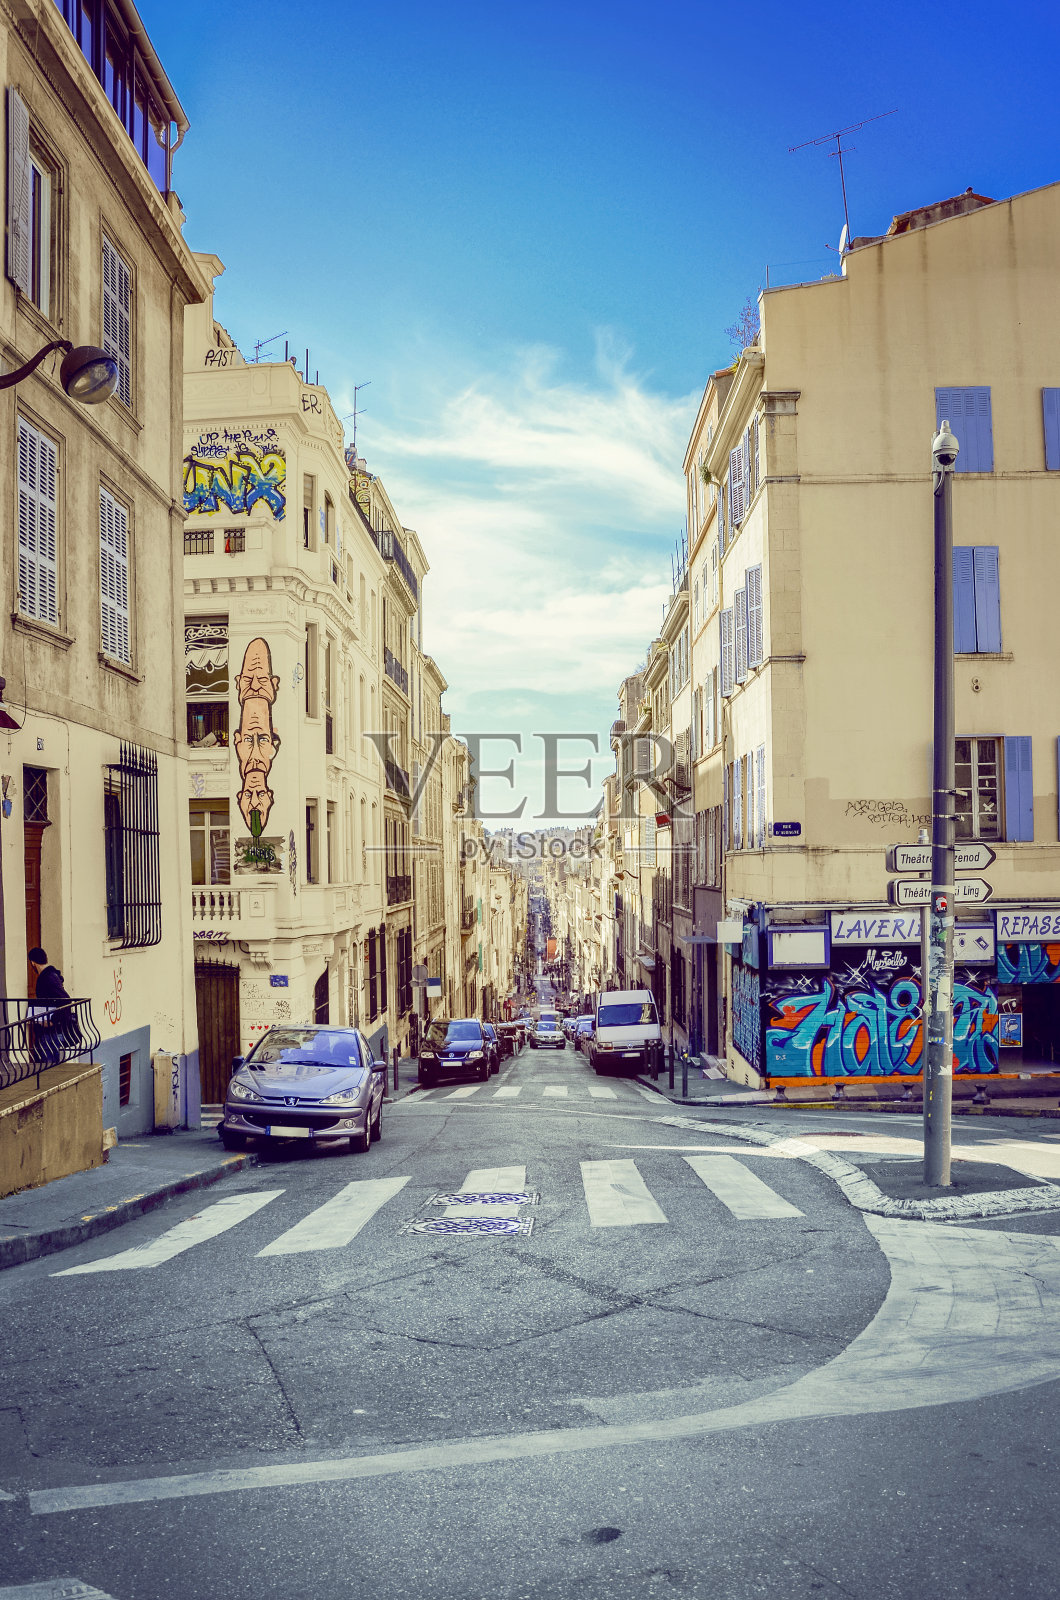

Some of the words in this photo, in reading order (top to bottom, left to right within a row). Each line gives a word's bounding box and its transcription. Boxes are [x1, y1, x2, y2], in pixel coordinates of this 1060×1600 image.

[205, 349, 236, 368] PAST
[954, 852, 980, 862] zenod
[904, 887, 931, 900] Théâtr
[963, 885, 980, 897] Ling
